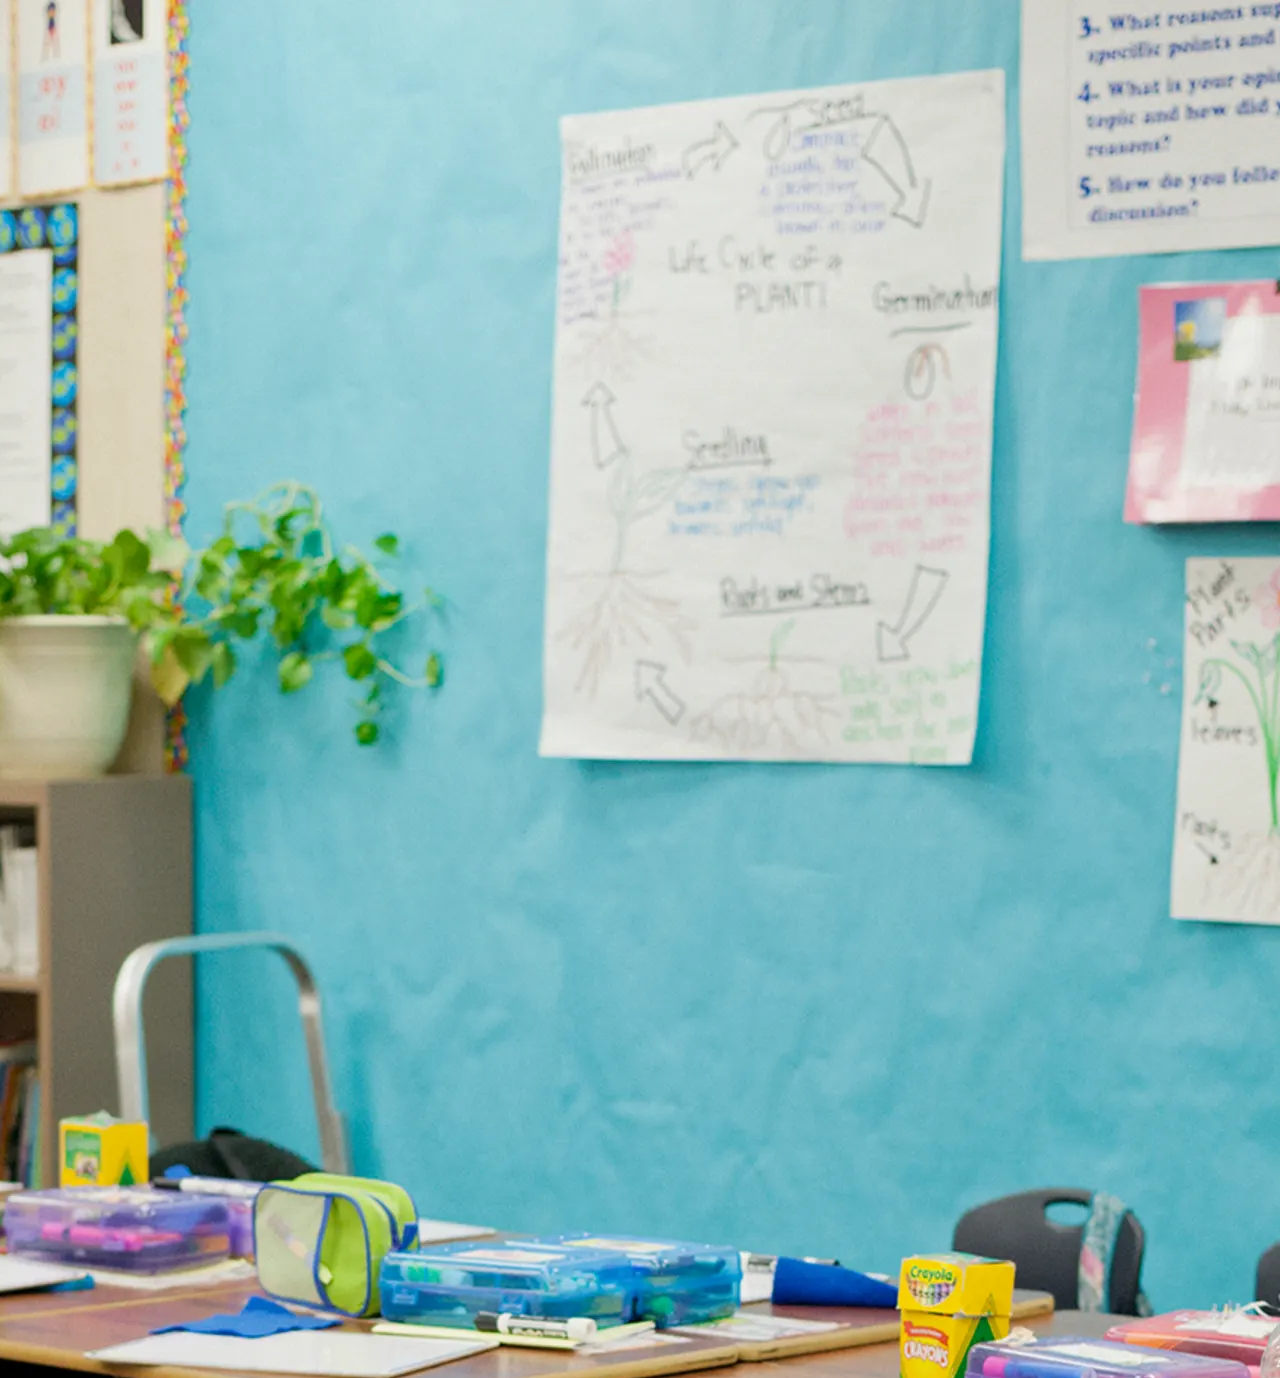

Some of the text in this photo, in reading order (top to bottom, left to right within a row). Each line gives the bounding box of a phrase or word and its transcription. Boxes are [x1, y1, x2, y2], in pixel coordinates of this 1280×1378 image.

[1079, 16, 1100, 38] 3.
[1109, 14, 1160, 30] What
[1167, 5, 1243, 26] reasons
[1089, 43, 1160, 65] specific
[1169, 35, 1231, 58] points
[1239, 29, 1275, 48] and
[1077, 83, 1100, 103] 4.
[1108, 80, 1160, 97] What
[1168, 77, 1181, 92] is
[1189, 75, 1235, 95] your
[1087, 112, 1135, 131] topic
[1144, 107, 1179, 124] and
[1186, 103, 1226, 121] how
[1236, 97, 1268, 116] did
[1086, 135, 1172, 158] reasons?
[1079, 176, 1100, 198] 5.
[1108, 174, 1150, 193] How
[1160, 174, 1182, 190] do
[1190, 172, 1226, 191] you
[1089, 199, 1199, 224] discussion?
[910, 1265, 953, 1283] Crayola
[904, 1340, 948, 1368] CRAYONS
